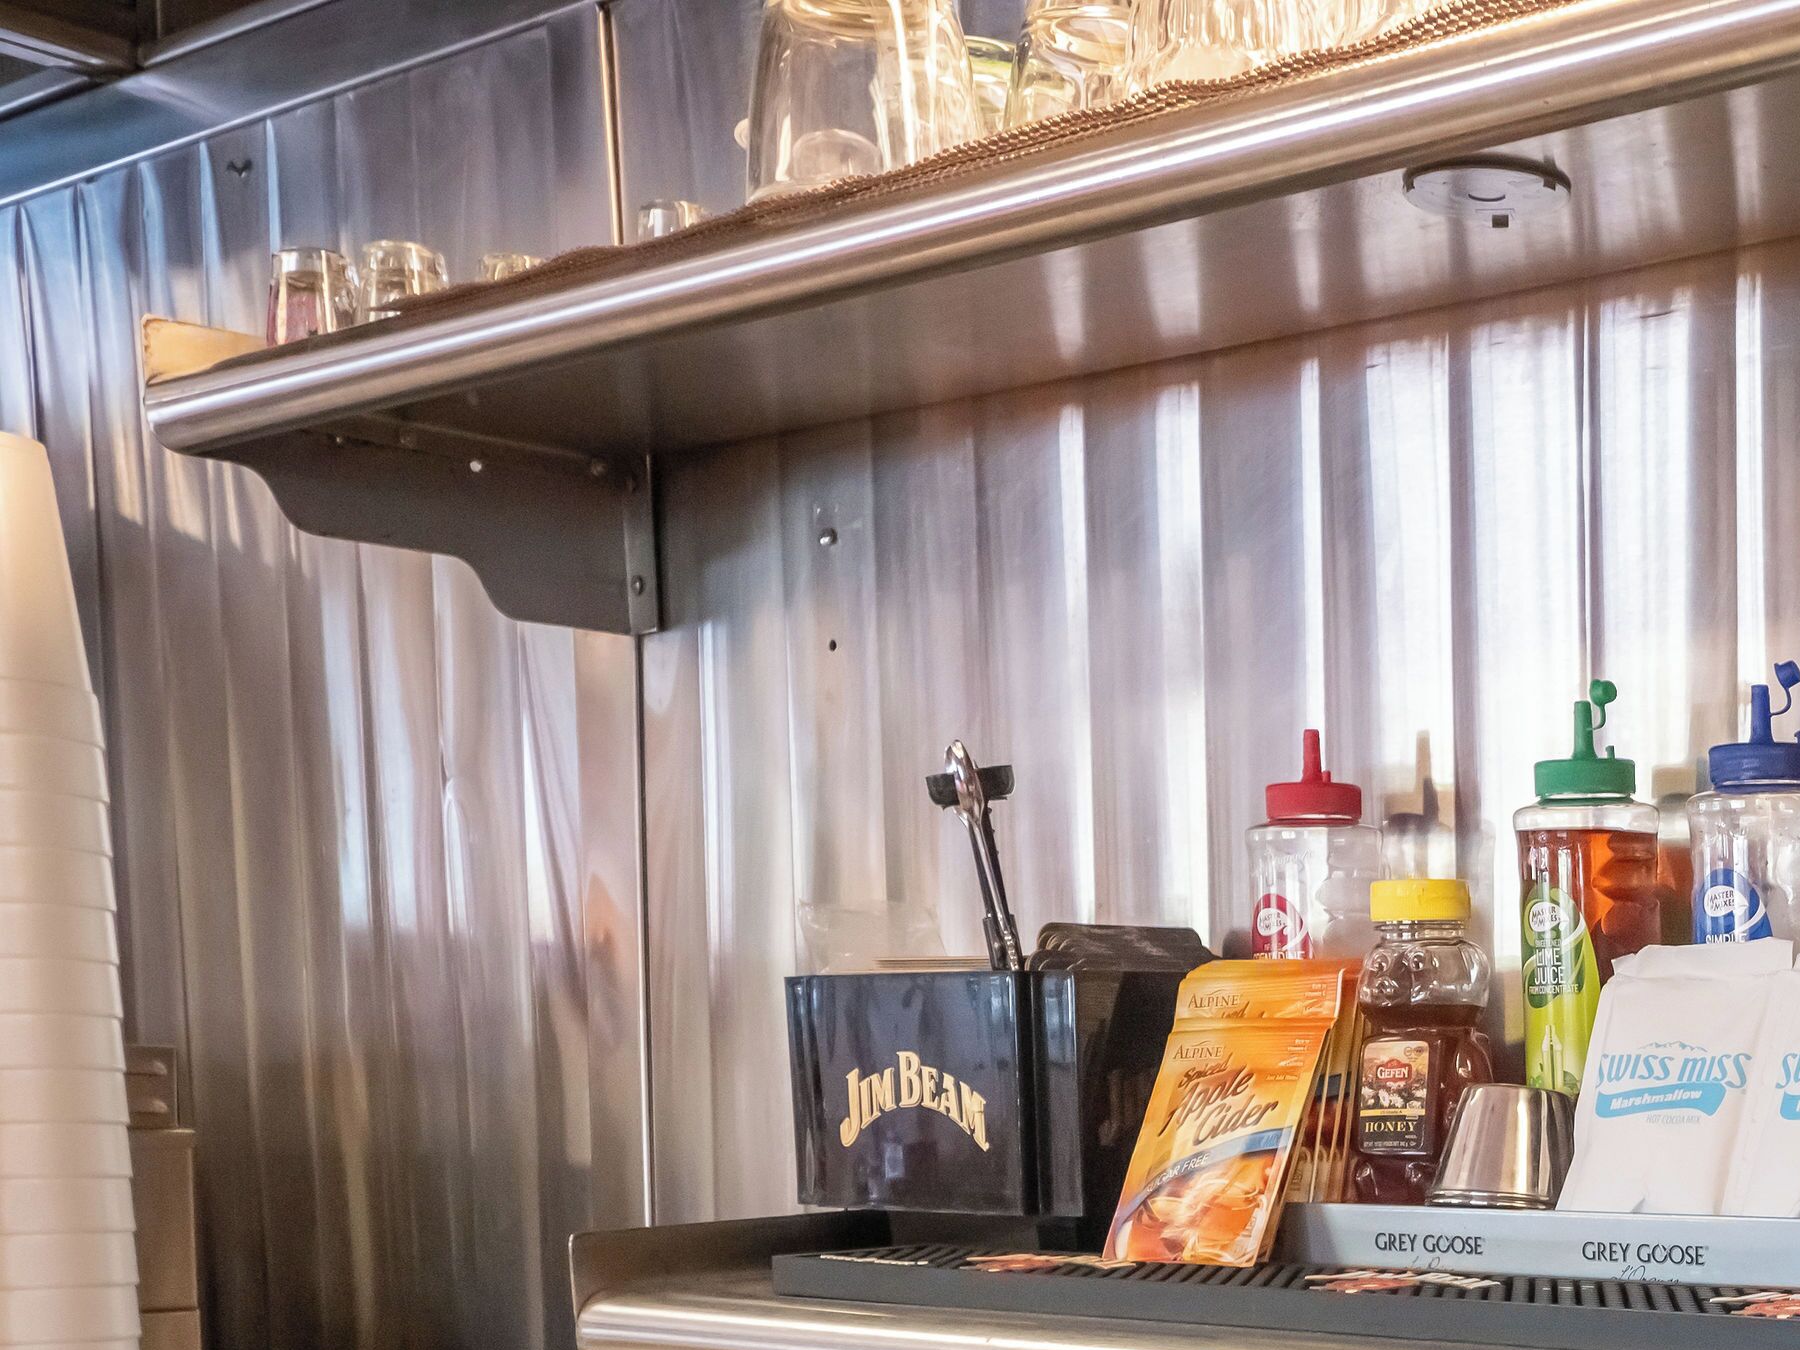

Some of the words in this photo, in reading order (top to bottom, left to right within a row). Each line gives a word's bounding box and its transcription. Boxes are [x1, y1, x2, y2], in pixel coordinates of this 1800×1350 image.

[1536, 948, 1562, 966] LIME
[1534, 967, 1566, 984] JUICE
[1188, 993, 1241, 1009] ALPINE
[1172, 1044, 1226, 1060] ALPINE
[1178, 1052, 1233, 1089] Spiced
[1376, 1066, 1409, 1079] GEFEN
[839, 1067, 897, 1148] JIM
[896, 1051, 990, 1152] BEAM
[1158, 1064, 1255, 1137] Apple
[1610, 1088, 1702, 1110] Marshmallow
[1192, 1094, 1279, 1147] Cider
[1365, 1121, 1417, 1133] HONEY
[1646, 1115, 1661, 1124] HOT
[1662, 1115, 1685, 1125] COCOA
[1685, 1115, 1702, 1124] MIX
[1180, 1152, 1211, 1172] FREE
[1375, 1232, 1418, 1253] GREY
[1423, 1234, 1484, 1255] GOOSE
[1581, 1241, 1631, 1263] GREY
[1636, 1243, 1705, 1266] GOOSE
